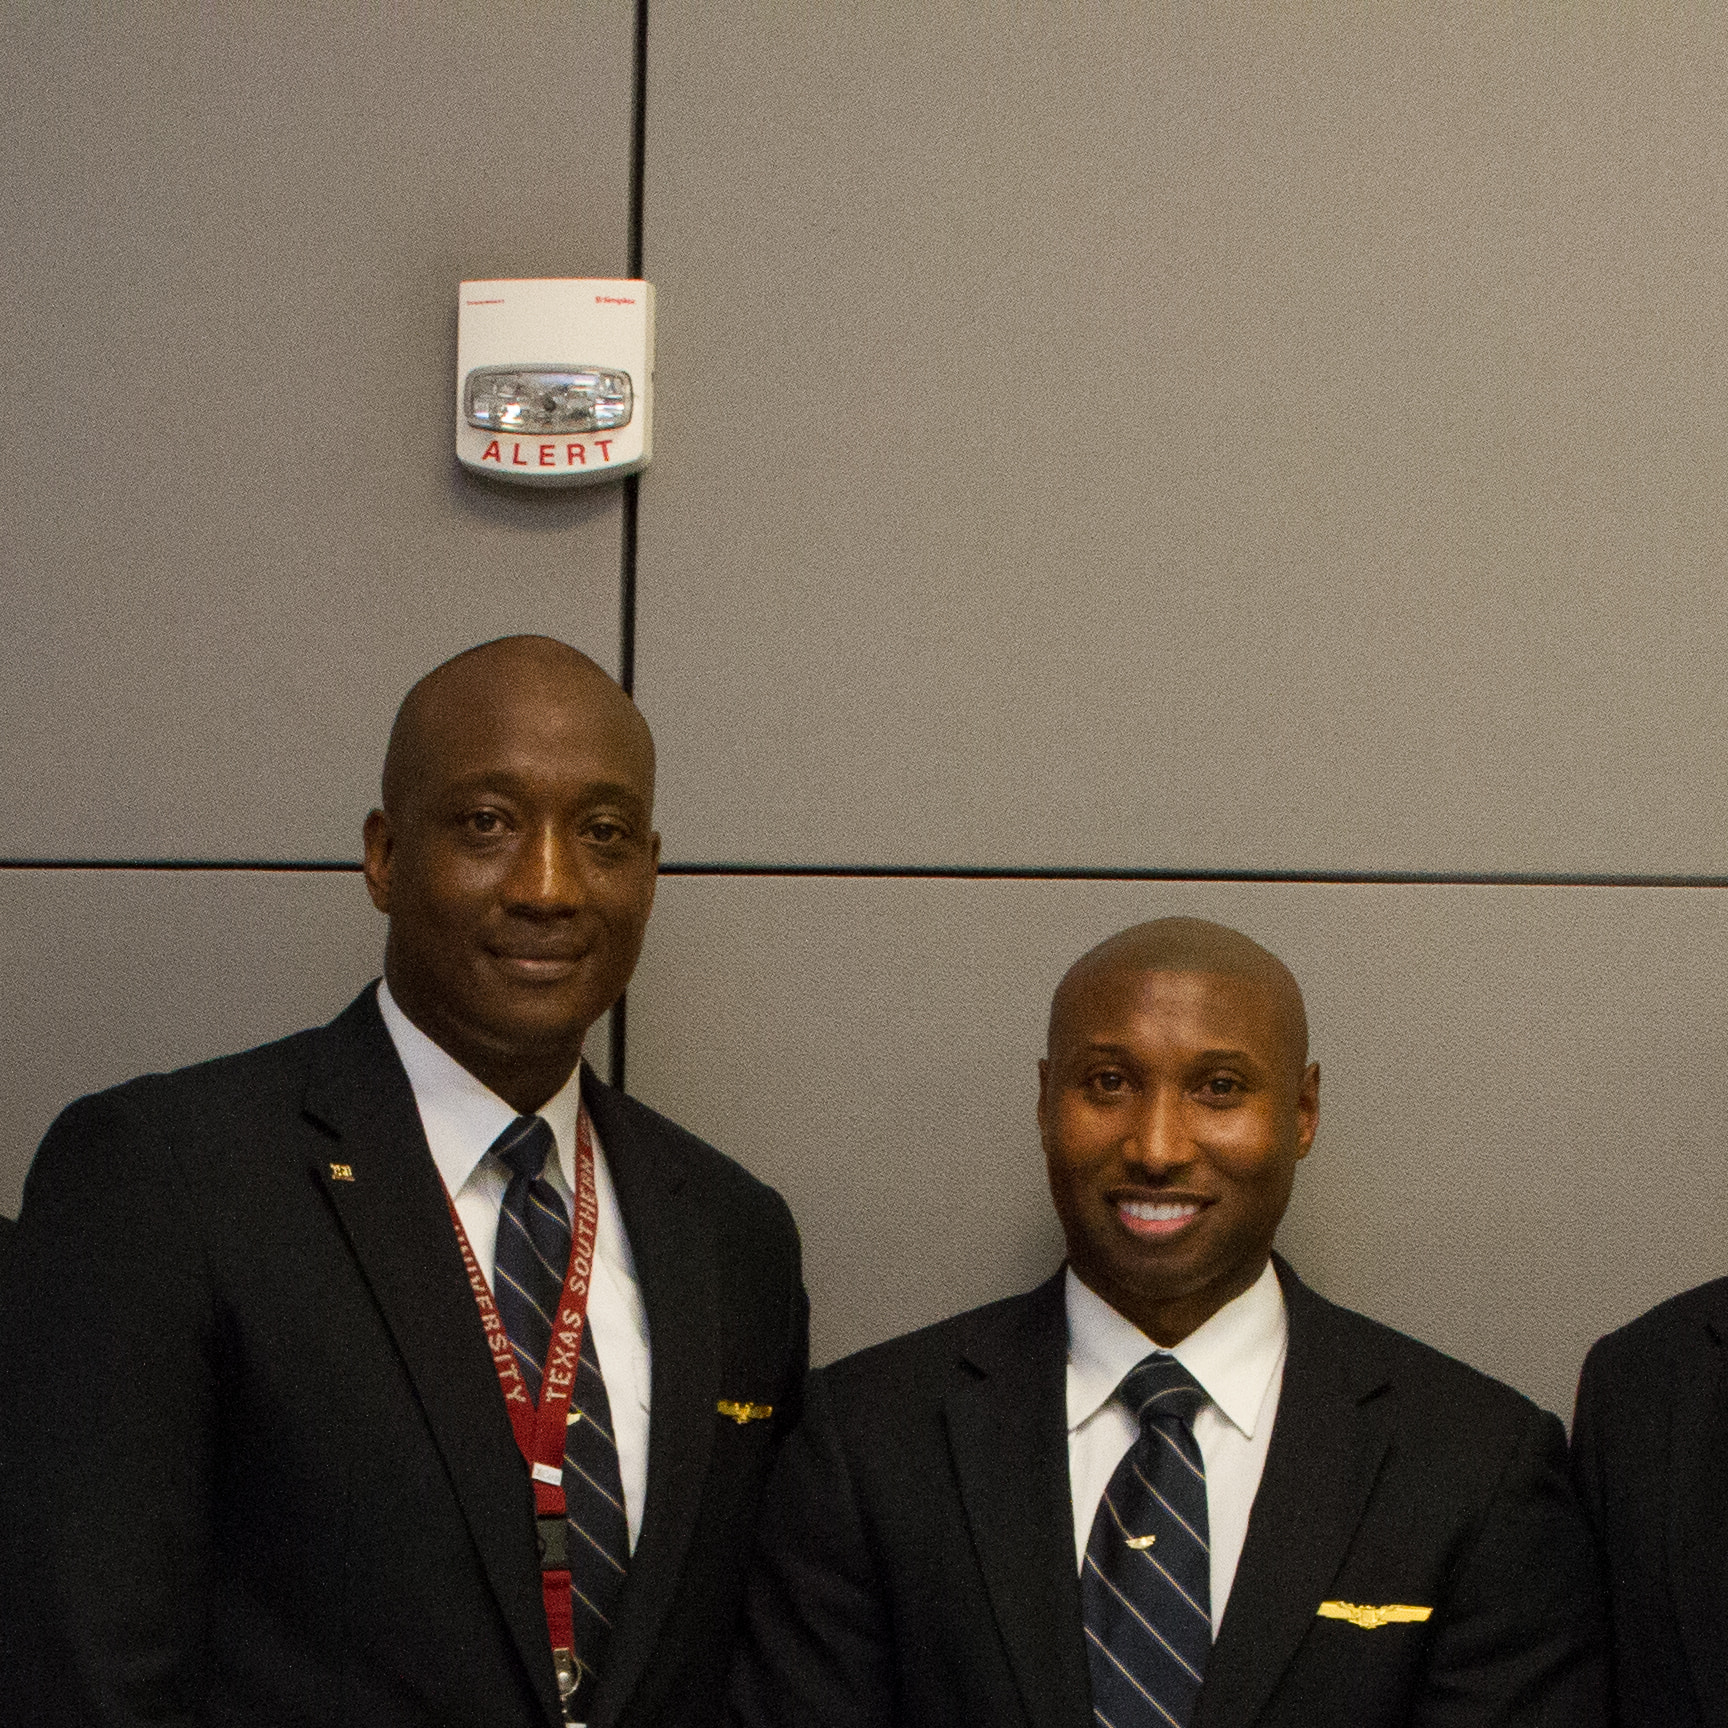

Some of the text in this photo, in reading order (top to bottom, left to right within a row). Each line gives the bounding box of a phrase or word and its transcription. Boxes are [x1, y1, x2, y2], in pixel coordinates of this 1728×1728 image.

[482, 440, 613, 466] ALERT
[545, 1308, 582, 1403] TEXAS
[570, 1154, 597, 1296] SOUTHERN
